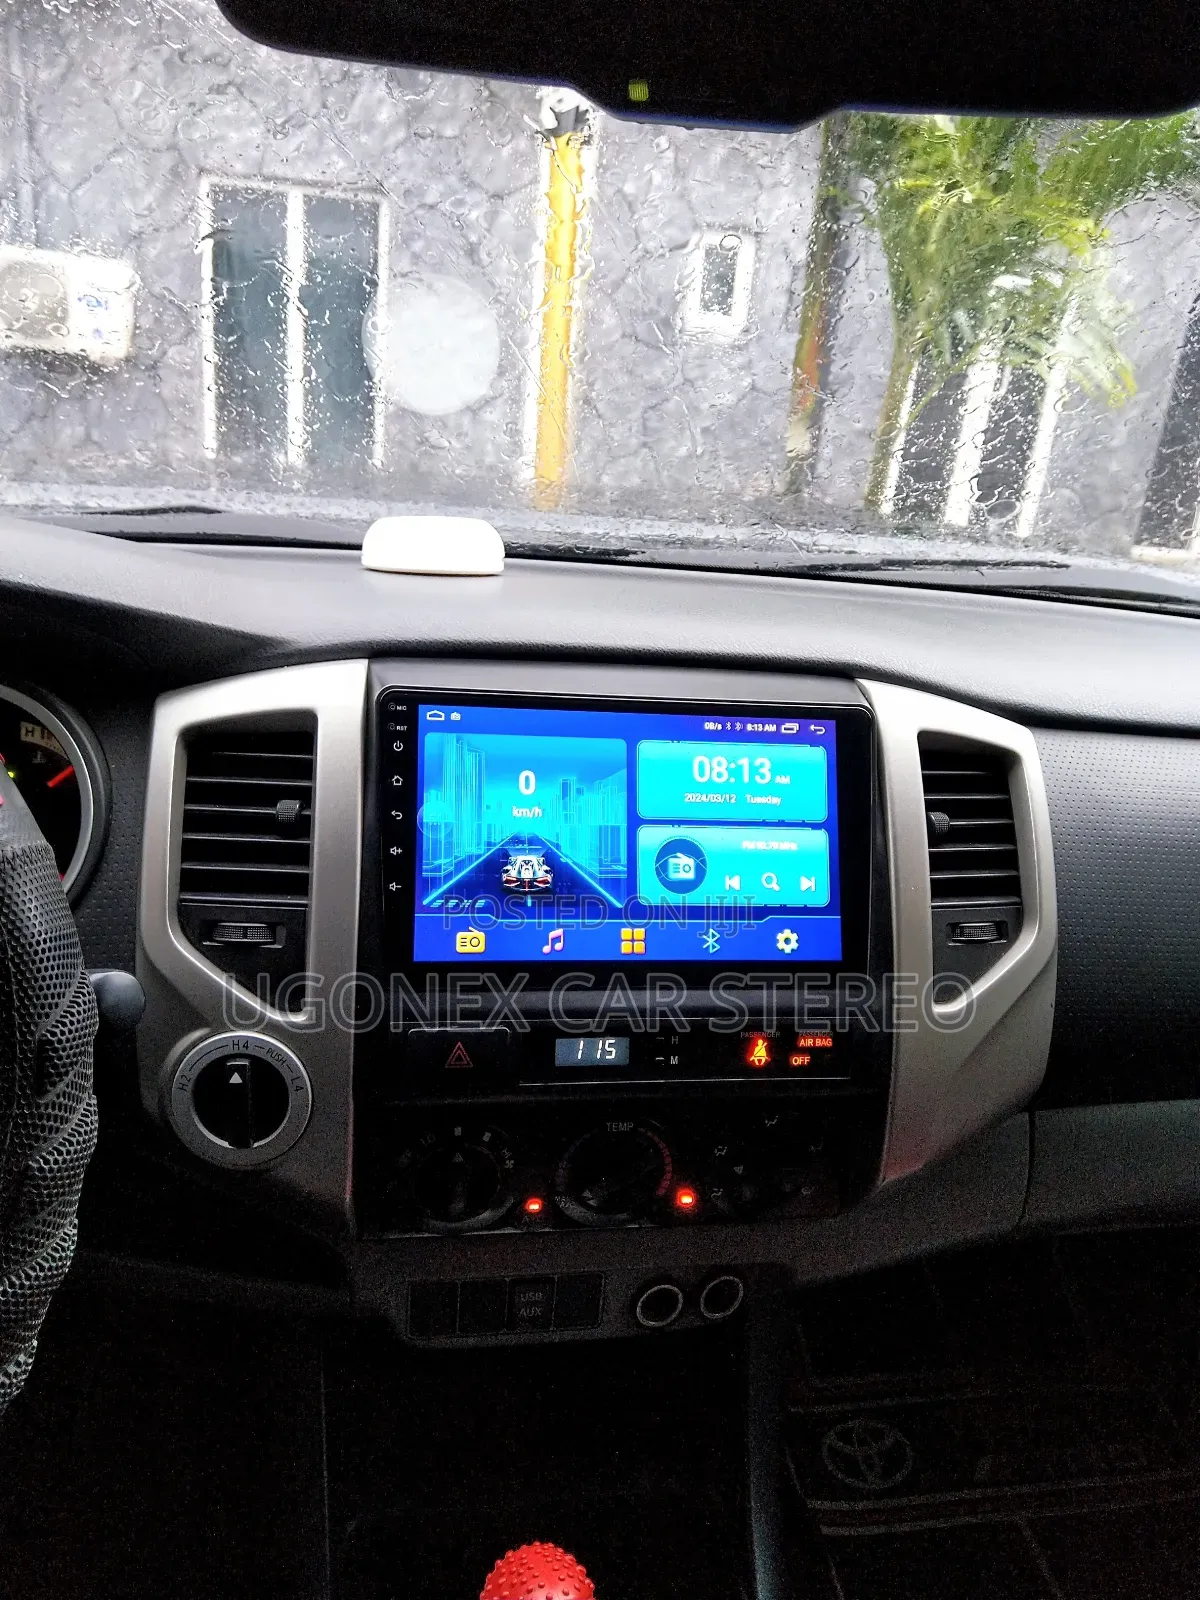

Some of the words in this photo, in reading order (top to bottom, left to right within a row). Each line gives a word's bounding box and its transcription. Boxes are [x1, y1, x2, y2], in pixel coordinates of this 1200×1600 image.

[25, 726, 35, 737] H
[746, 723, 763, 732] 8:13
[764, 723, 777, 733] AM
[692, 755, 772, 784] 08:13
[774, 775, 791, 785] AM
[518, 769, 536, 795] 0
[684, 792, 736, 803] 2024/03/12
[745, 794, 782, 805] Tuesday
[512, 805, 543, 818] km/h
[671, 1035, 679, 1045] H
[740, 1031, 781, 1039] PASSENGER
[799, 1038, 814, 1047] AIR
[815, 1038, 833, 1047] BAG
[265, 1047, 287, 1067] PUSH
[670, 1055, 679, 1065] M
[792, 1056, 811, 1066] OFF
[605, 1121, 634, 1133] TEMP
[518, 1306, 542, 1318] AUX
